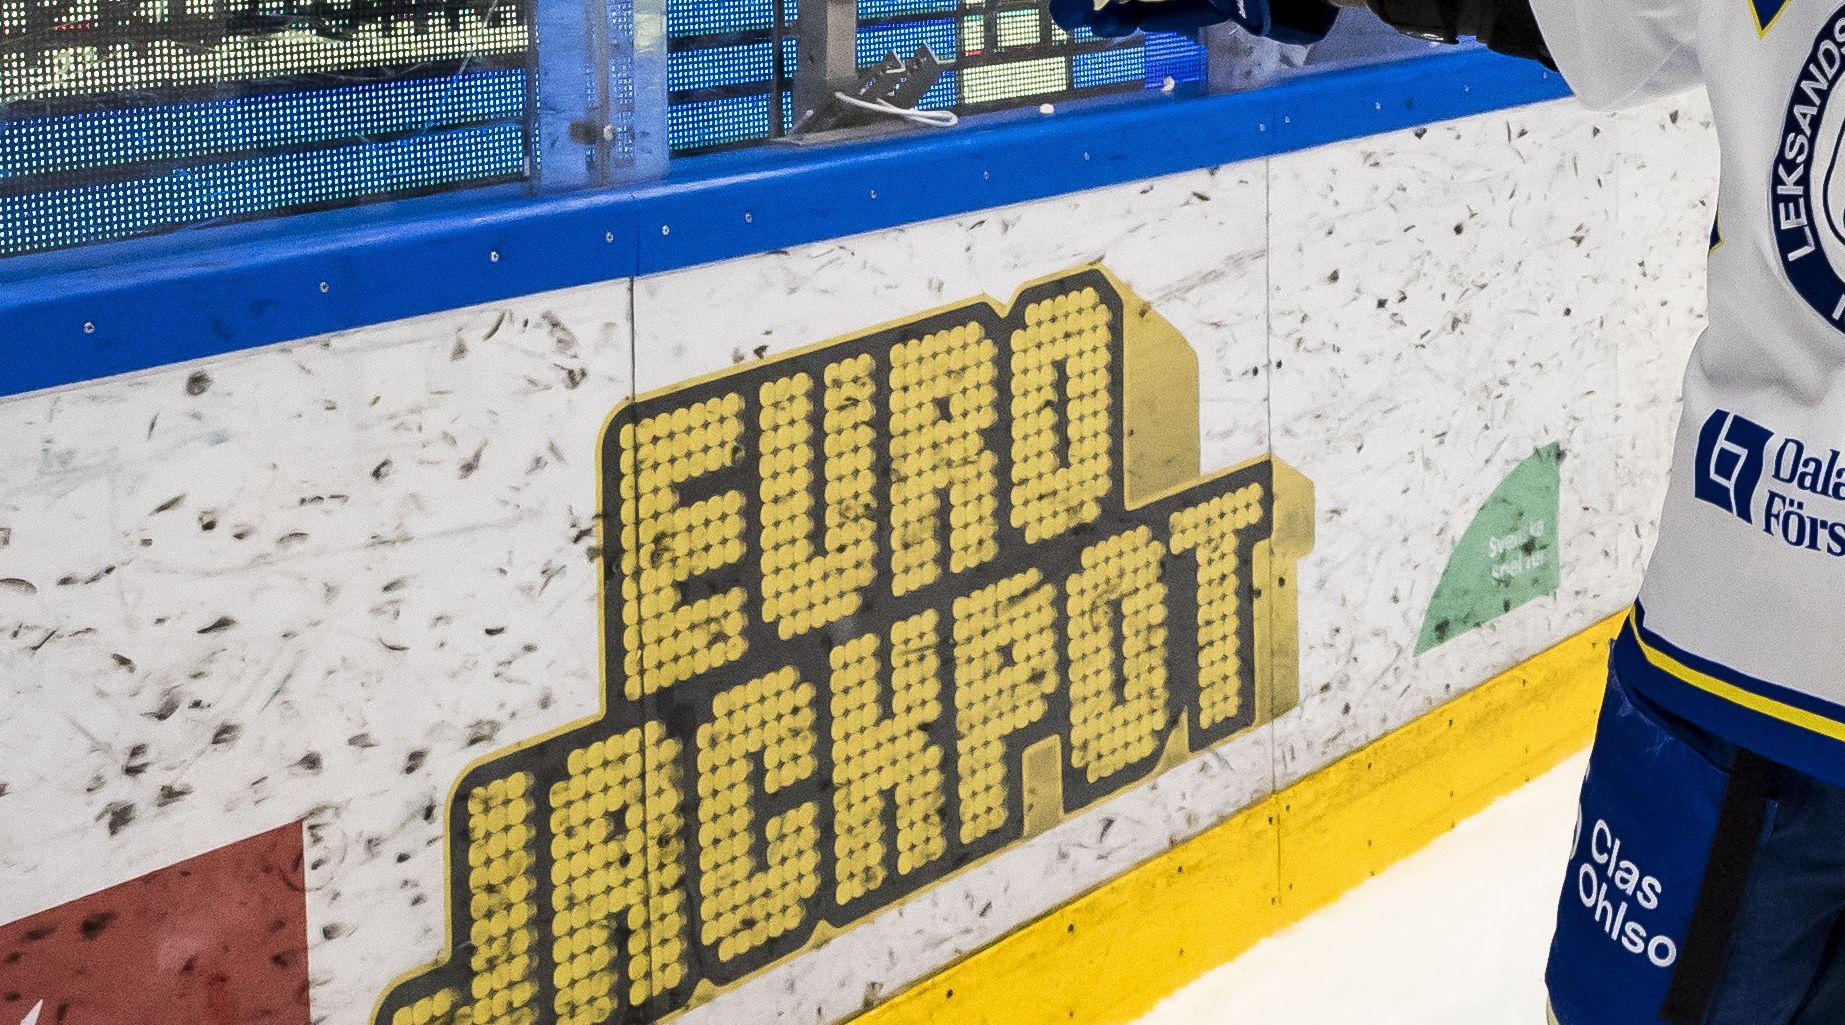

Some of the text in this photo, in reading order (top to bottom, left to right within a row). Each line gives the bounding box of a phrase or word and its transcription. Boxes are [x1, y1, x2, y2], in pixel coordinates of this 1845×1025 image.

[618, 285, 1113, 702] EURO
[390, 482, 1264, 1025] JACKPOT
[1590, 818, 1663, 910] Clas
[1578, 862, 1678, 968] Ohlso
